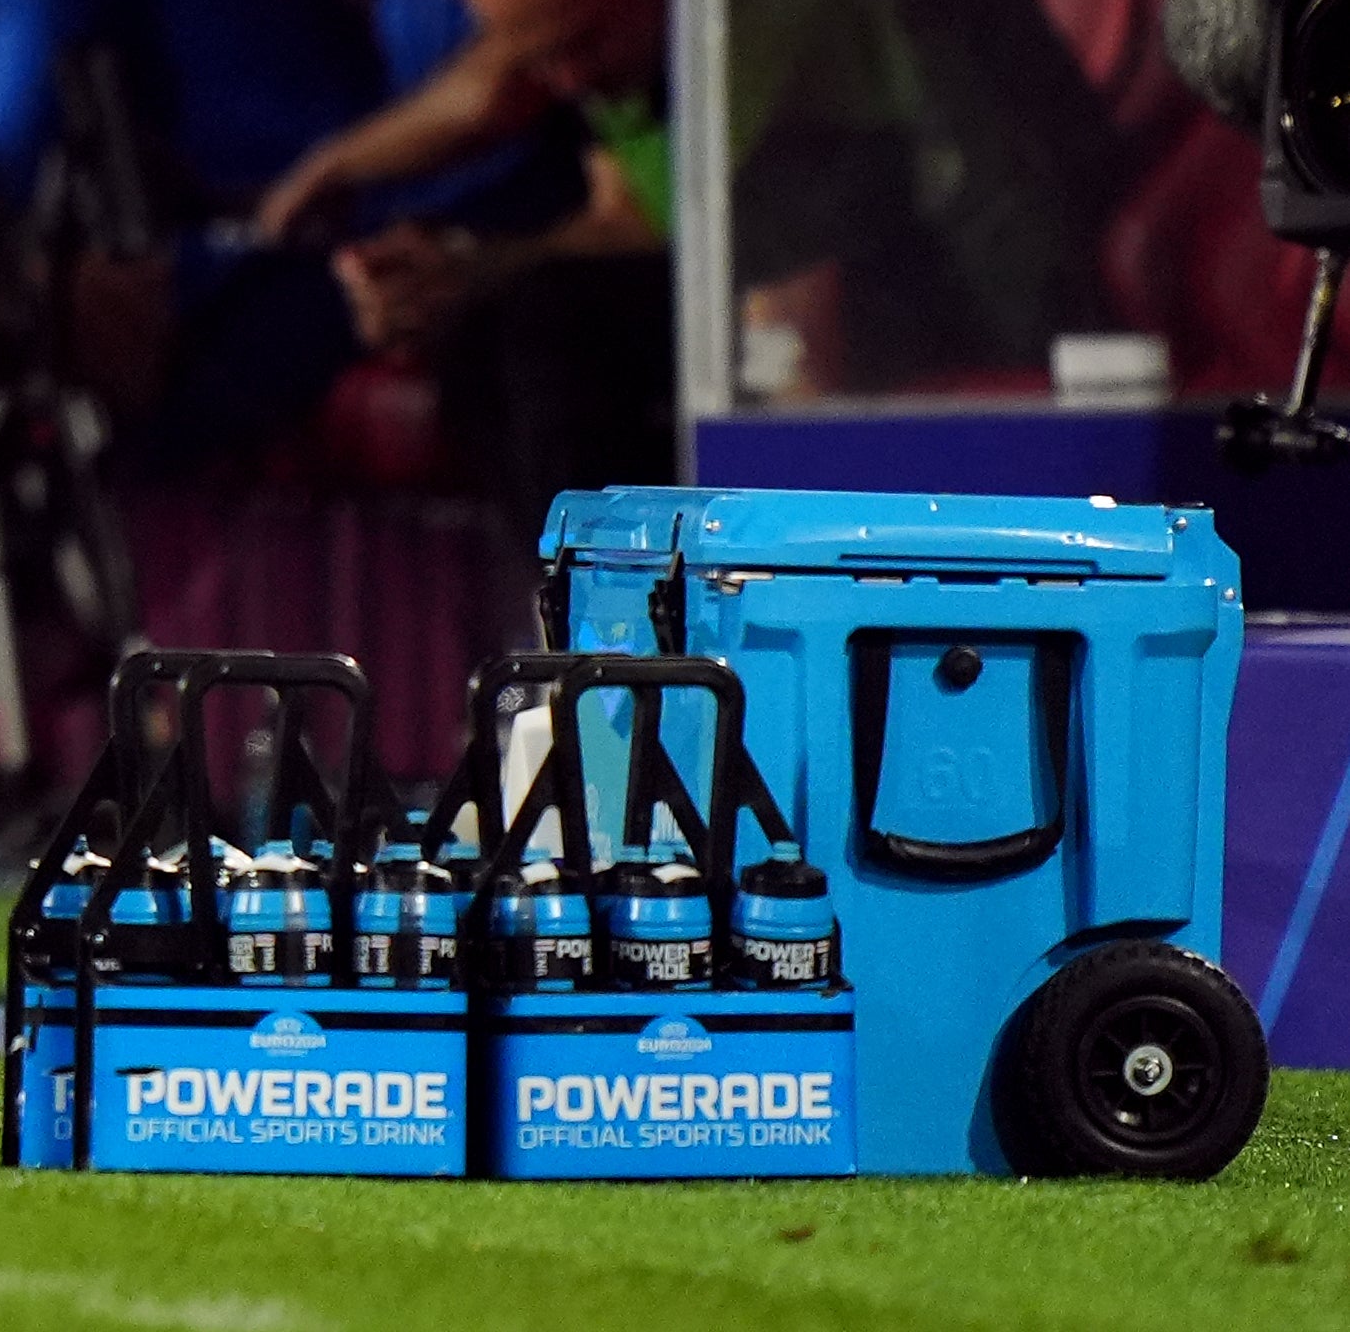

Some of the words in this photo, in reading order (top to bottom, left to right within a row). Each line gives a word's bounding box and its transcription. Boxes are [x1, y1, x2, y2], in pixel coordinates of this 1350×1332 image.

[619, 942, 690, 965] POWER
[744, 939, 815, 965] POWER
[646, 962, 692, 981] ADE
[771, 961, 815, 980] ADE
[127, 1070, 448, 1119] POWERADE
[517, 1072, 833, 1121] POWERADE
[127, 1117, 243, 1144] OFFICIAL
[250, 1118, 358, 1145] SPORTS
[363, 1119, 446, 1146] DRINK
[518, 1124, 633, 1149] OFFICIAL
[638, 1123, 745, 1148] SPORTS
[750, 1121, 833, 1147] DRINK
